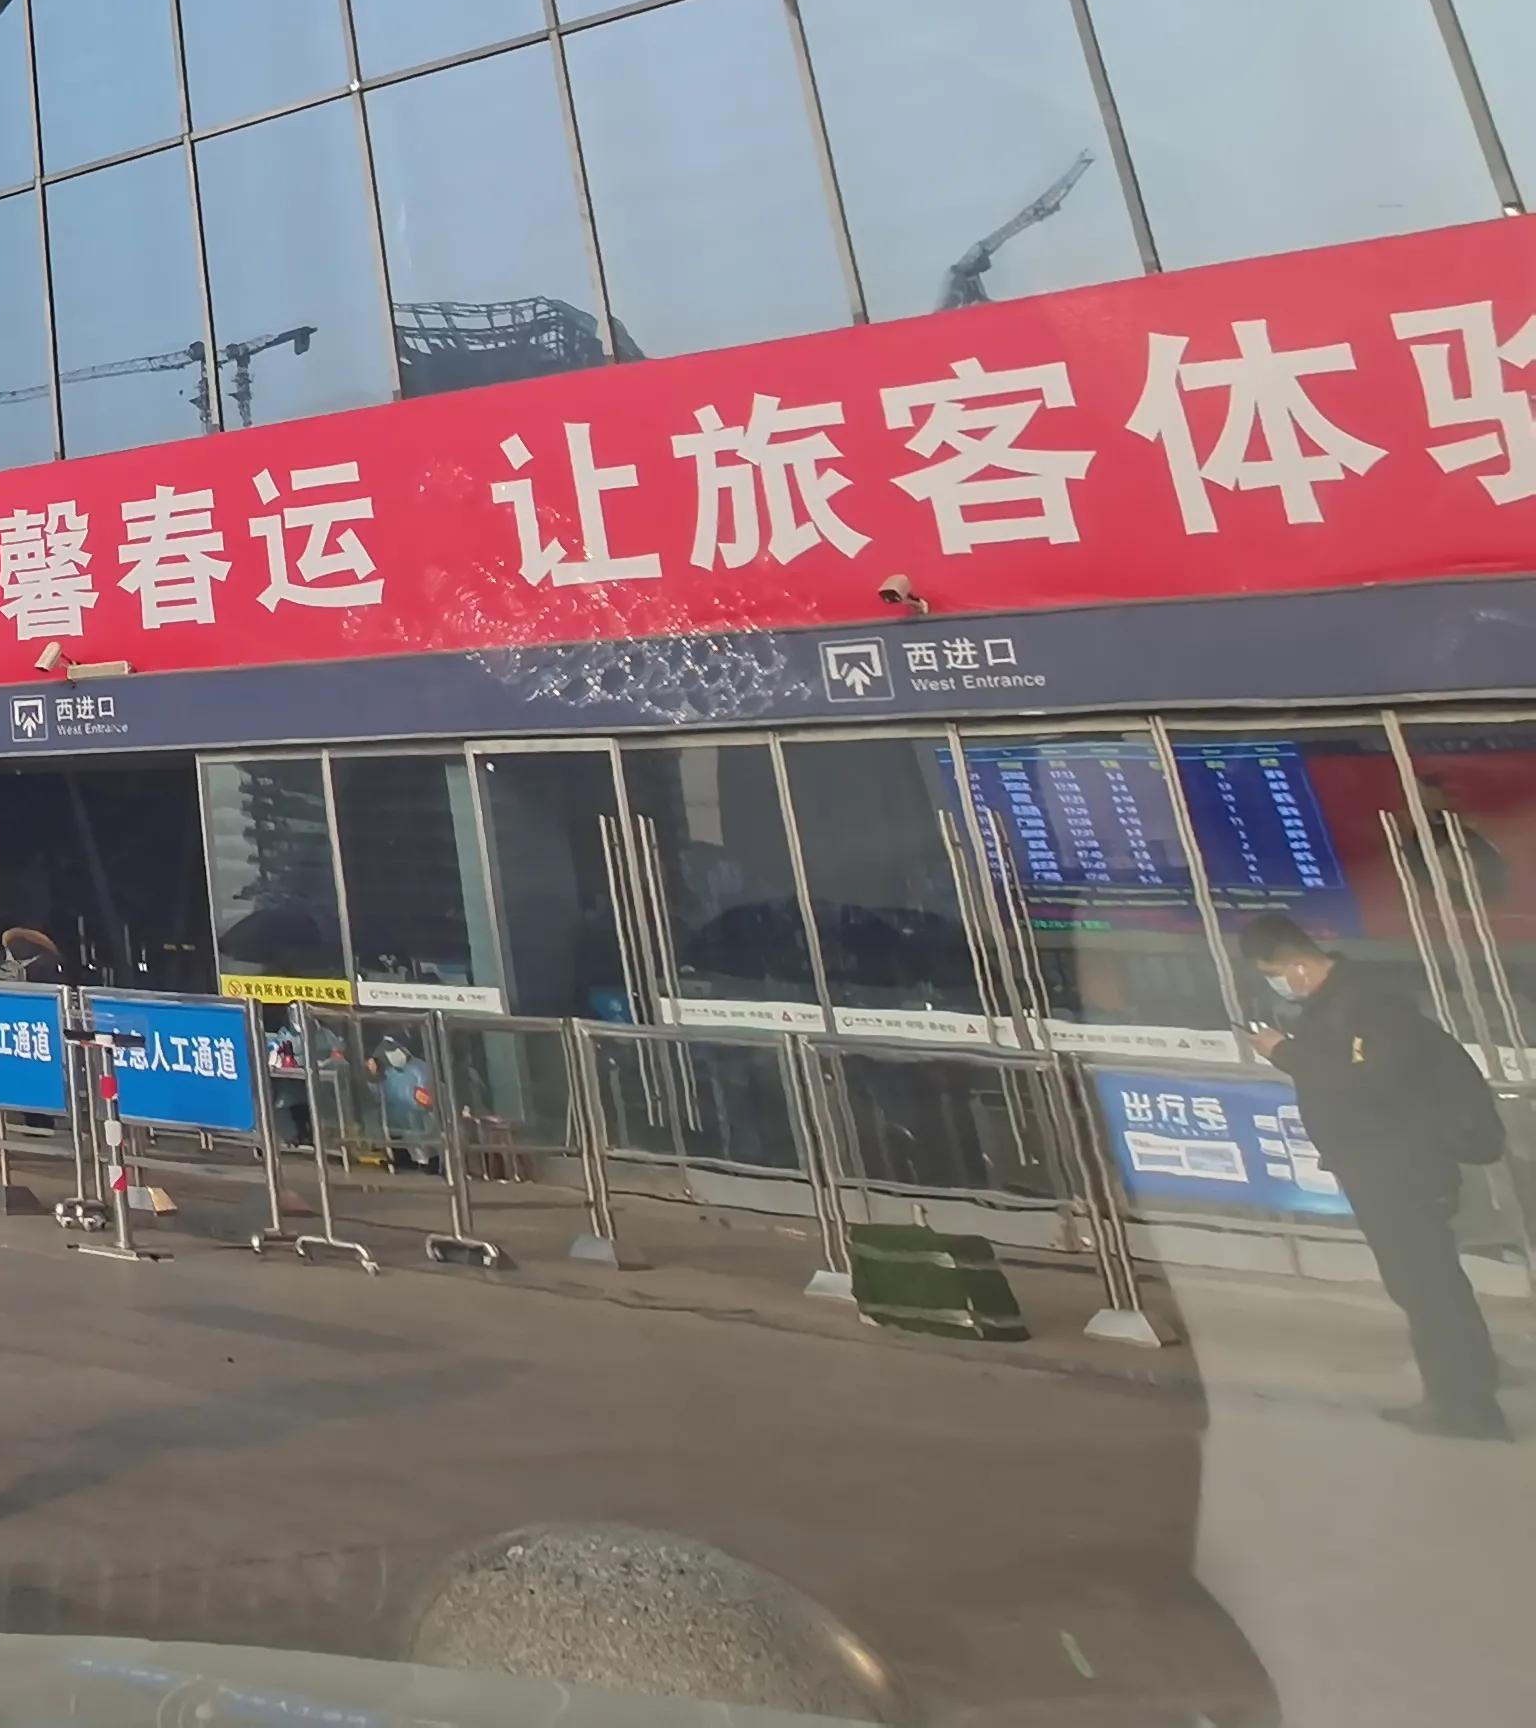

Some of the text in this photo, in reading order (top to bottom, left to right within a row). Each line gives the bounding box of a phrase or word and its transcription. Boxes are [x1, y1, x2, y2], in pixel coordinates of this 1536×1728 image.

[902, 637, 1018, 673] 西进口
[910, 673, 1047, 692] West Entrance
[55, 695, 115, 721] 西进口
